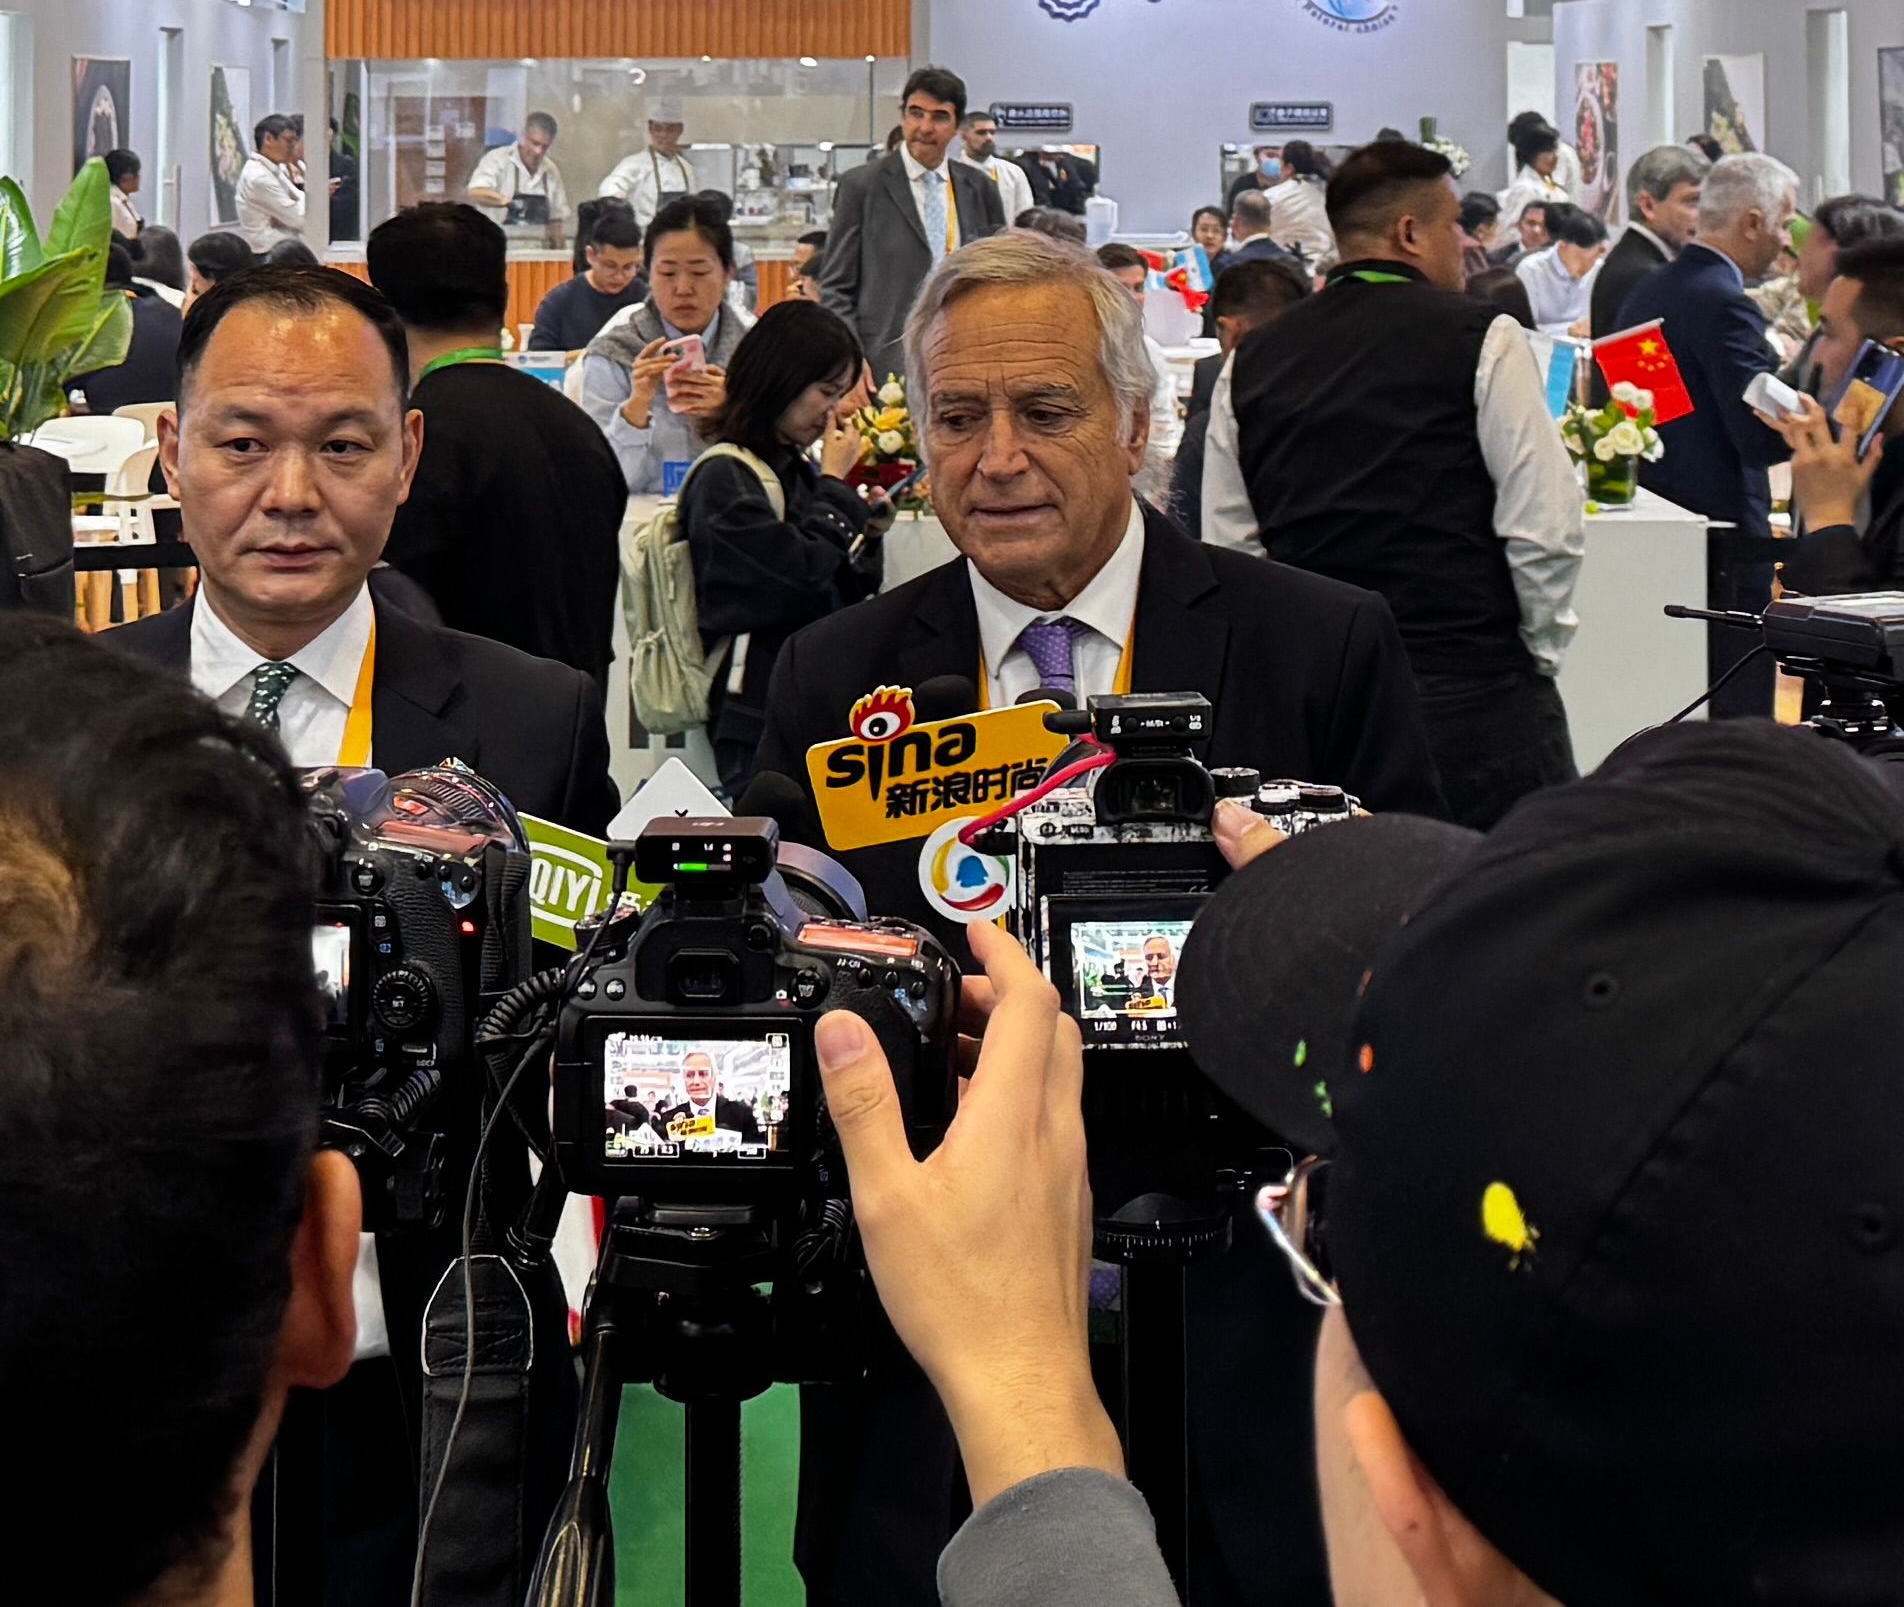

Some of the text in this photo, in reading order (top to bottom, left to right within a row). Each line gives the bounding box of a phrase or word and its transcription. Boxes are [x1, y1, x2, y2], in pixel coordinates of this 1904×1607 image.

[826, 722, 977, 802] sina
[885, 756, 1050, 819] 新浪时尚
